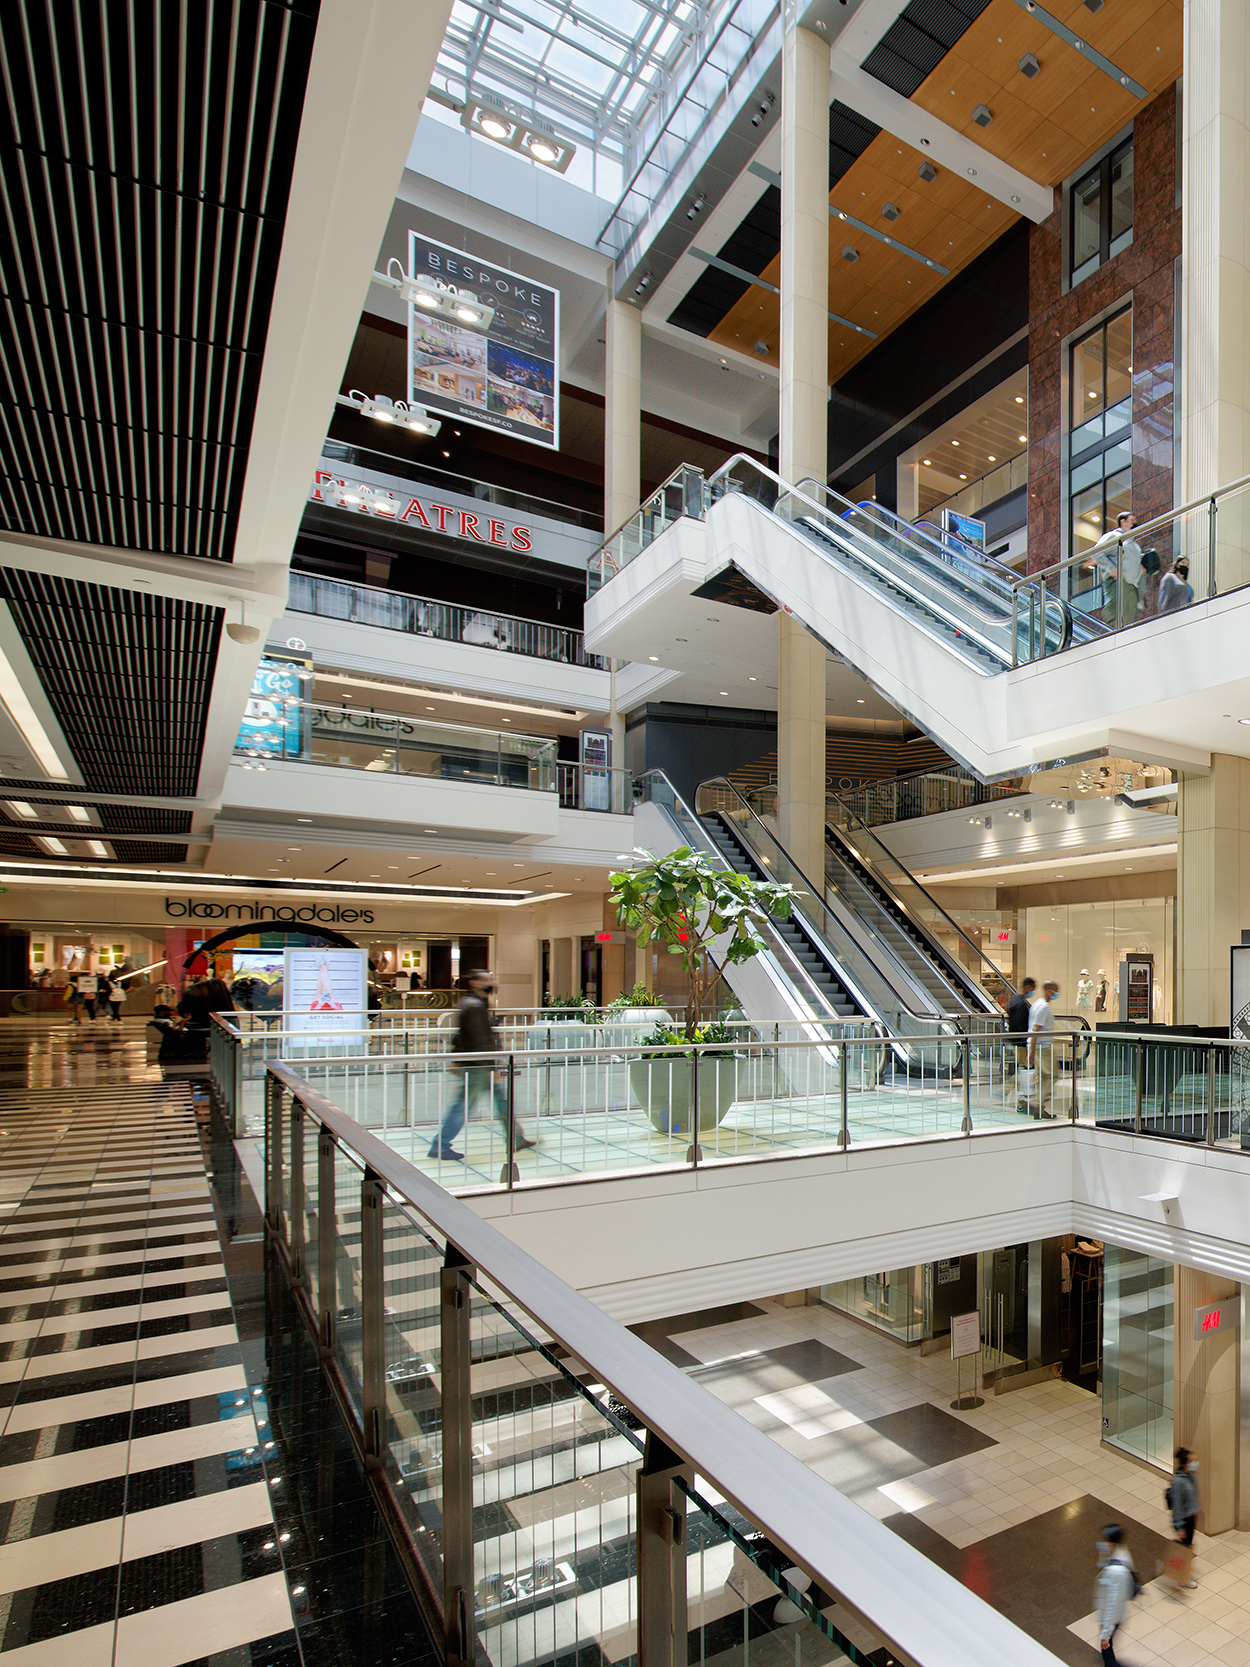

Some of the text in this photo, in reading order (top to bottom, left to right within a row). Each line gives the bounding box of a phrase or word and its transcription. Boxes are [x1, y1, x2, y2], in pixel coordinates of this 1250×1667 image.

[428, 252, 542, 307] BESPOKE
[165, 897, 374, 923] bloomingdale's
[1202, 1309, 1221, 1332] H&M
